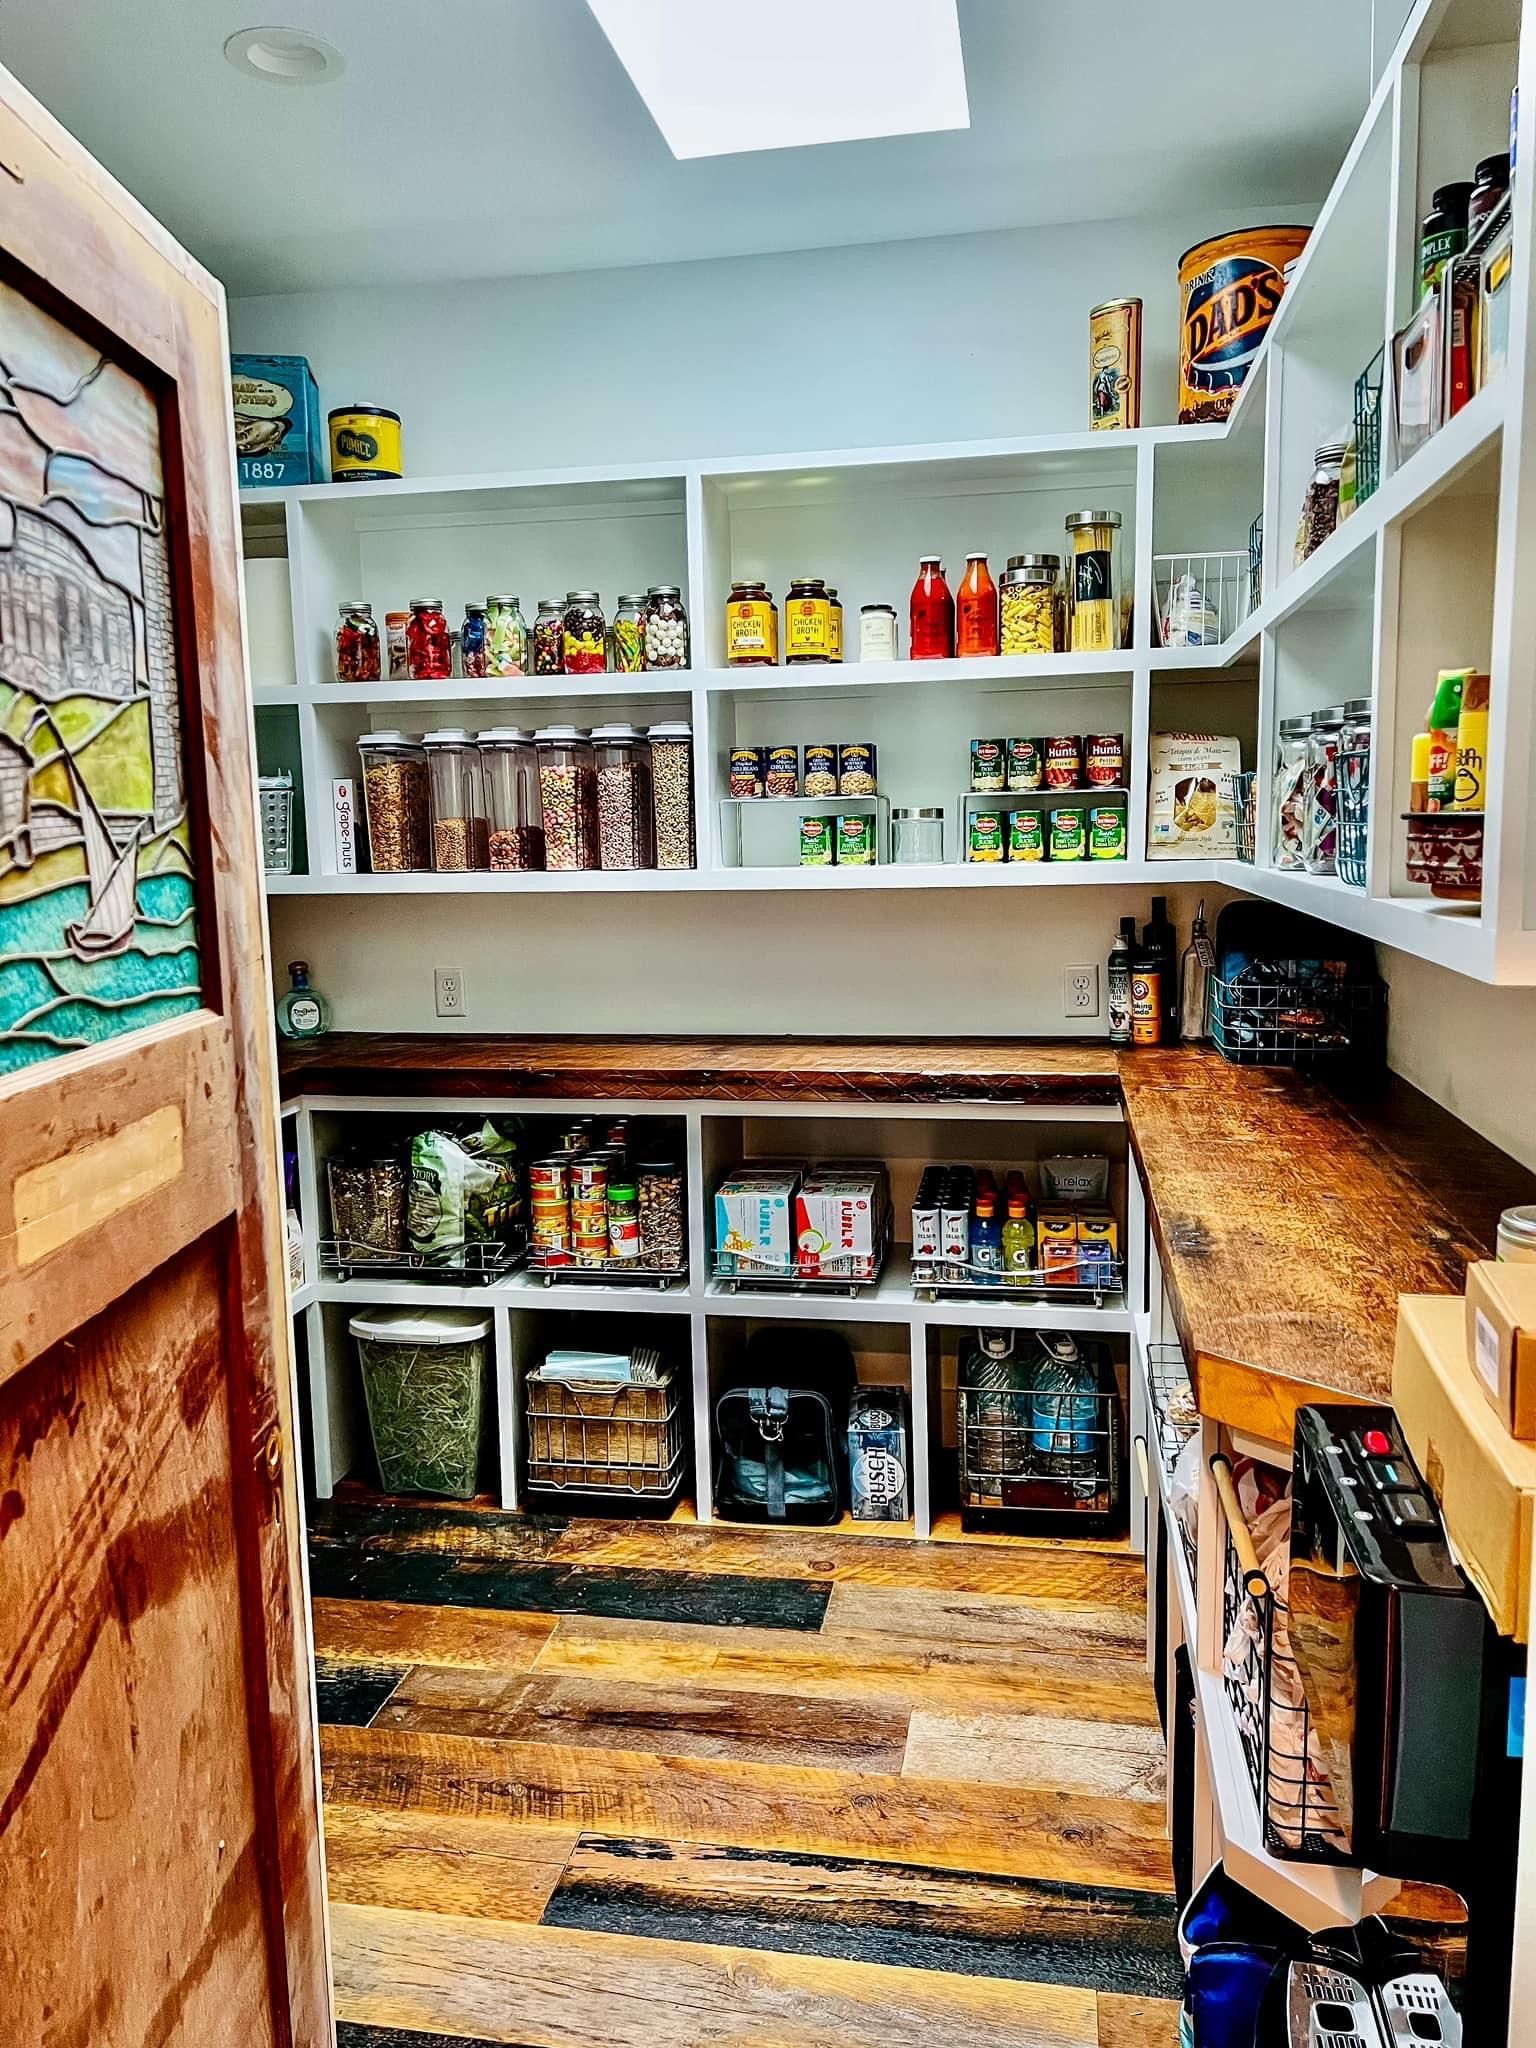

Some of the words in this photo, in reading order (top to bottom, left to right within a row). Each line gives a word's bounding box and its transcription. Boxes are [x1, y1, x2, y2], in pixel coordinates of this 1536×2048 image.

[1184, 267, 1217, 294] DRINK
[1188, 271, 1285, 359] DAD'S
[341, 433, 372, 458] PUMICE
[242, 463, 285, 479] 1887
[732, 619, 761, 630] CHICKEN
[793, 617, 823, 626] CHICKEN
[735, 629, 759, 637] BROTH
[796, 626, 820, 635] BROTH
[335, 801, 352, 868] grape-nuts
[1063, 1176, 1094, 1187] relax
[977, 1248, 991, 1262] G
[1012, 1249, 1026, 1264] G
[868, 1447, 888, 1506] BUSCH
[886, 1460, 897, 1494] LIGHT
